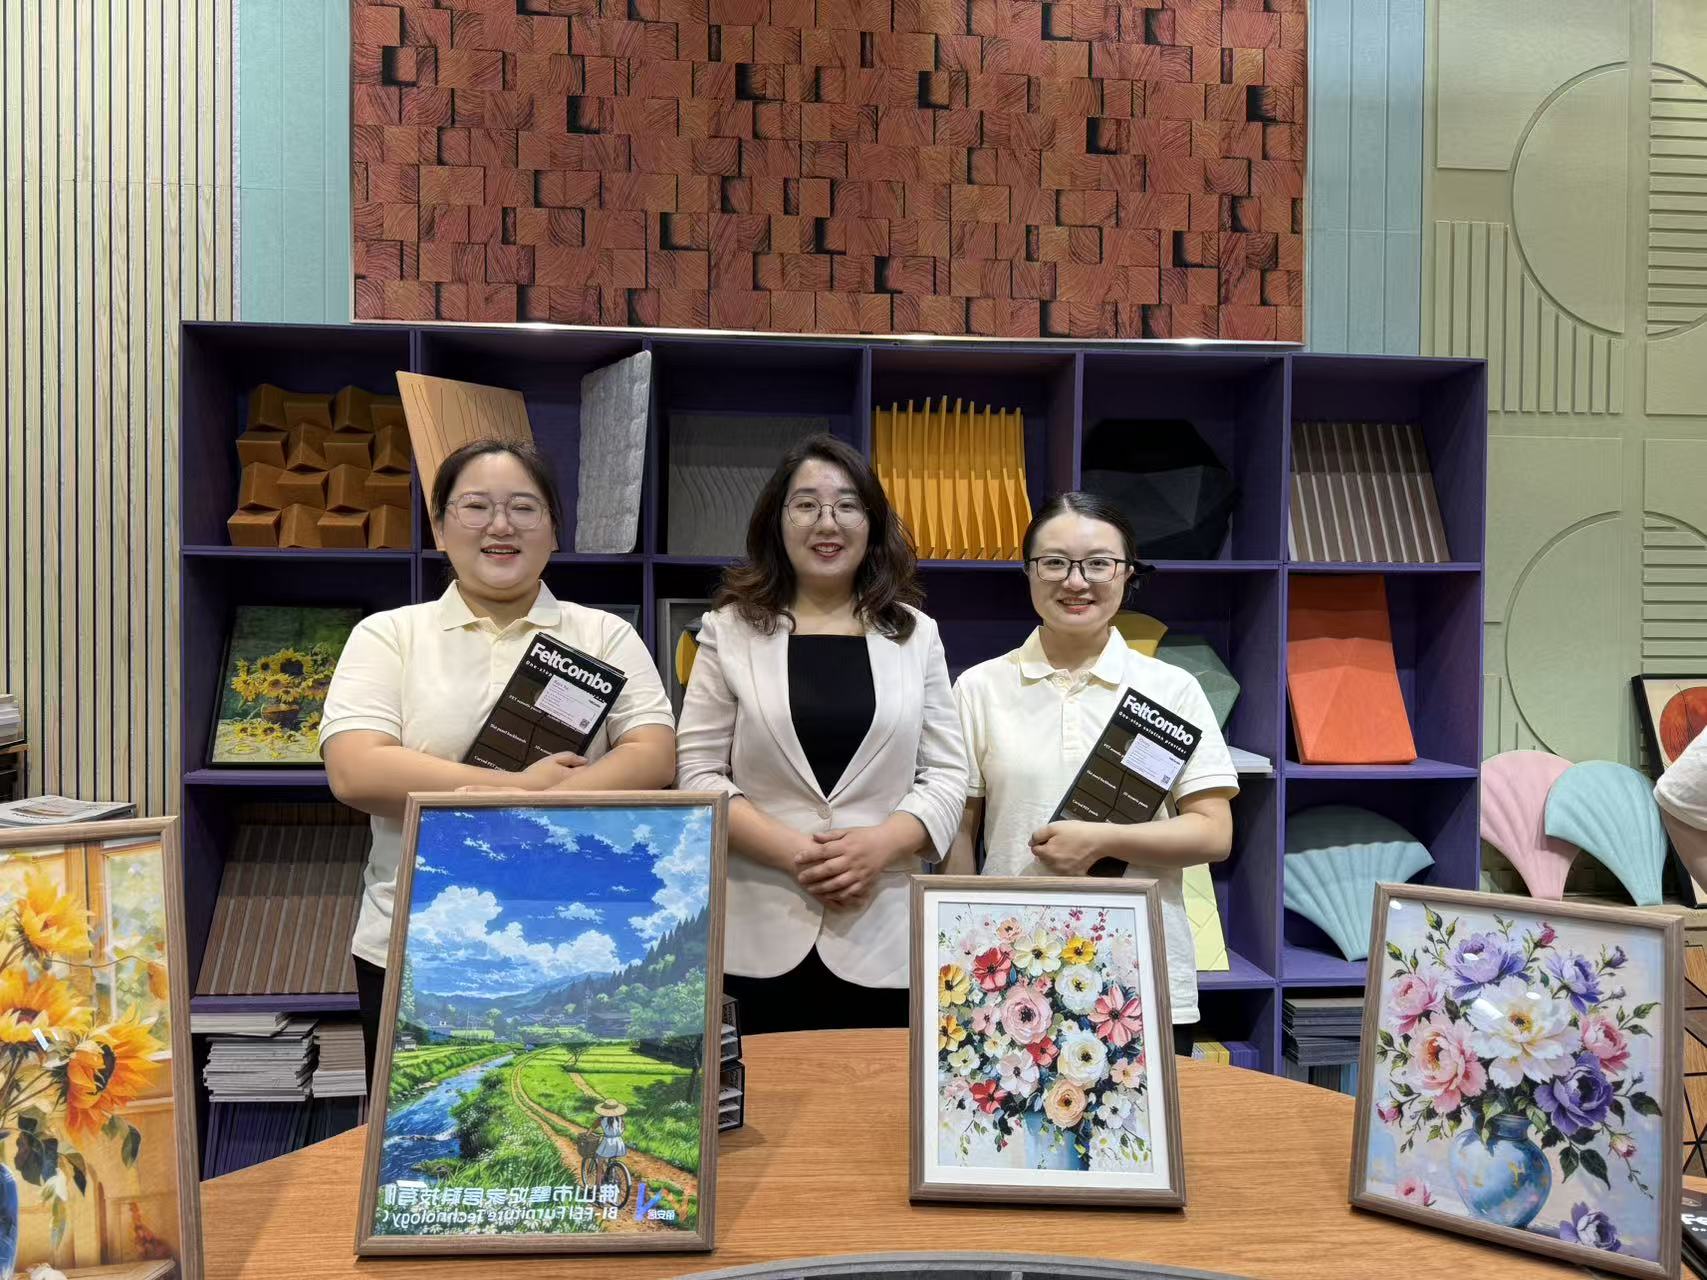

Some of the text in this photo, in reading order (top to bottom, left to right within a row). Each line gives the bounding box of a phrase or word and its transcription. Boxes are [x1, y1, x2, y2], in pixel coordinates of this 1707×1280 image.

[530, 642, 613, 694] FeltCombo
[1118, 711, 1142, 728] One-stop
[1142, 726, 1164, 741] solution
[1164, 739, 1187, 754] provider
[1122, 694, 1194, 746] FeltCombo
